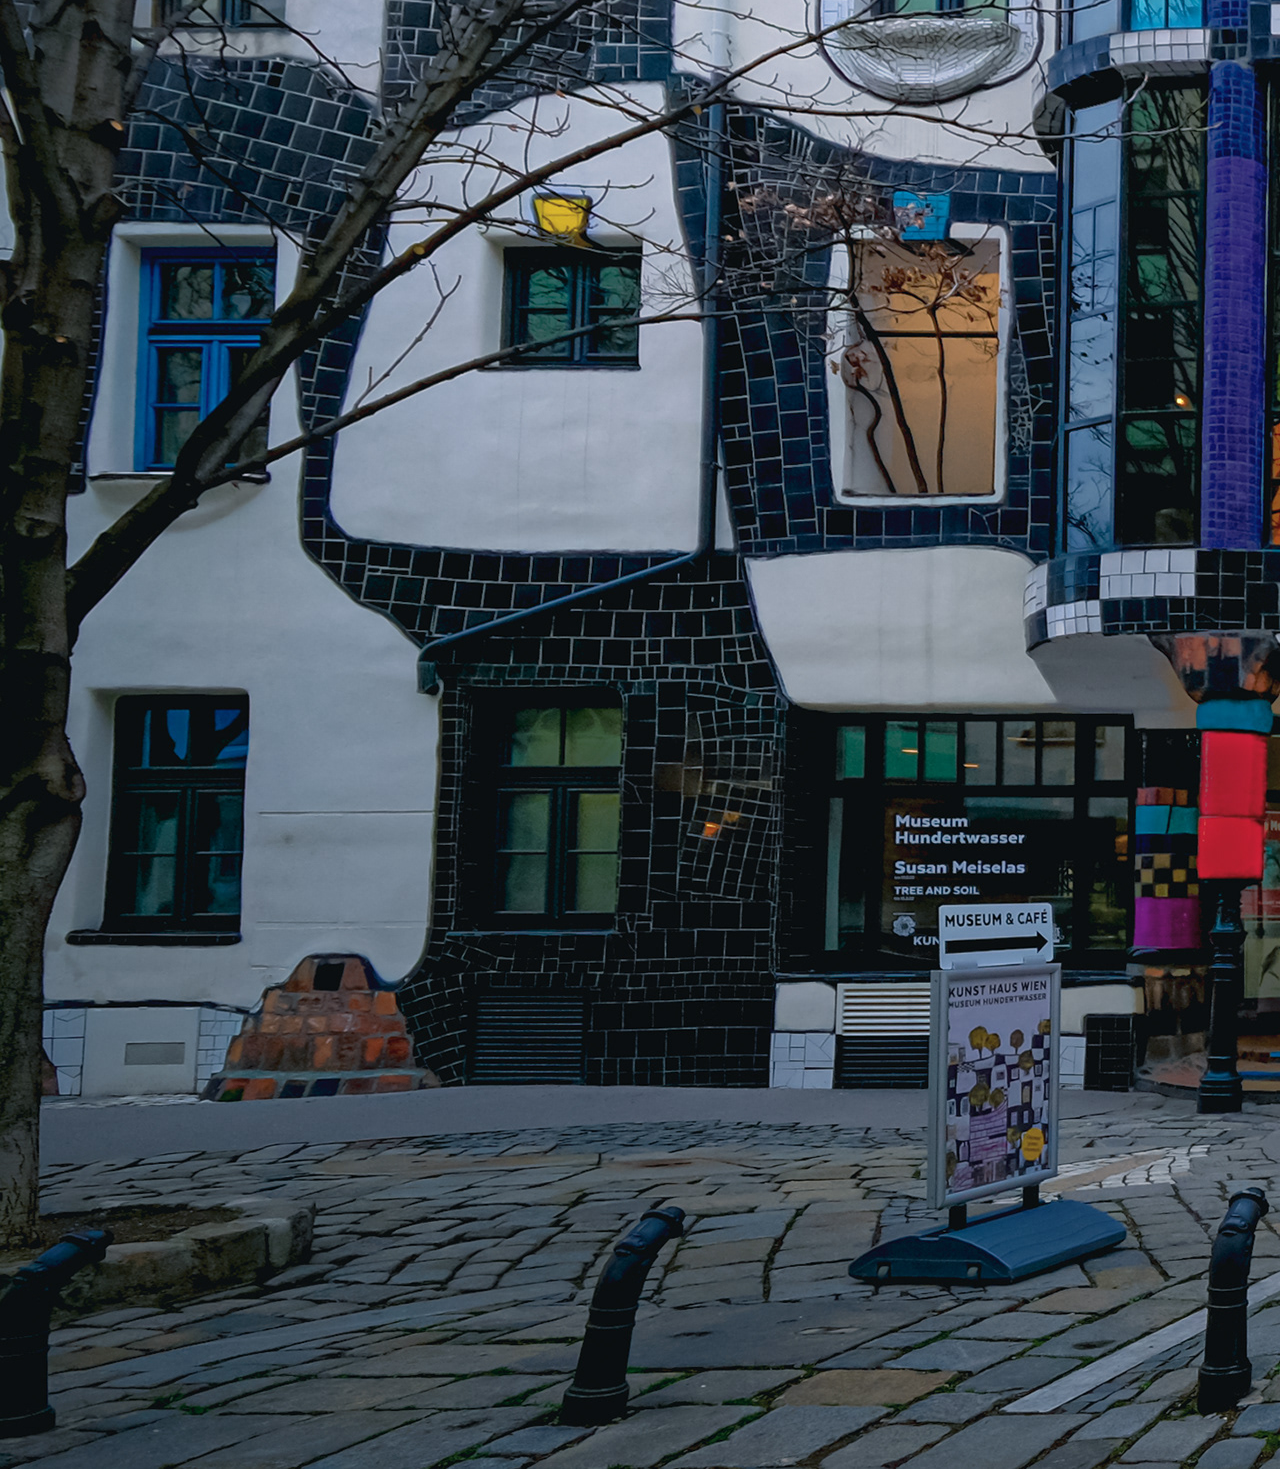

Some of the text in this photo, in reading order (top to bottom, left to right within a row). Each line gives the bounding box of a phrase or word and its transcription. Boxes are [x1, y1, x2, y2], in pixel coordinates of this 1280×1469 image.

[895, 814, 968, 828] Museum
[895, 831, 1025, 844] Hundertwasser
[894, 860, 1026, 874] Susan Meiselas
[894, 886, 980, 895] TREE AND SOIL
[945, 909, 1048, 927] MUSEUM & CAFÉ
[913, 936, 939, 946] KUN
[948, 980, 1047, 998] KUNST HAUS WIEN
[948, 993, 1046, 1008] MUSEUM HUNDERTWASSER
